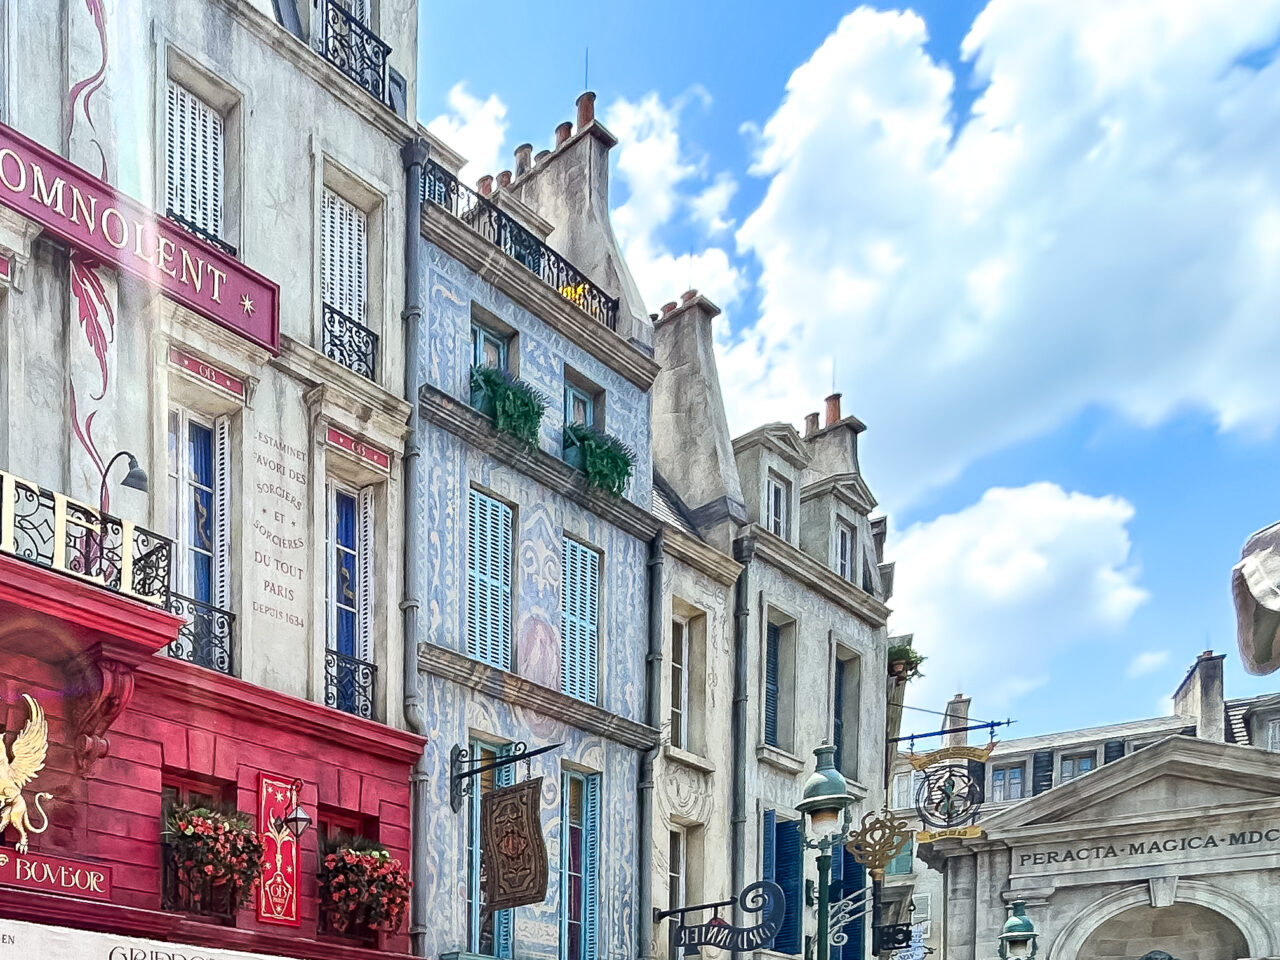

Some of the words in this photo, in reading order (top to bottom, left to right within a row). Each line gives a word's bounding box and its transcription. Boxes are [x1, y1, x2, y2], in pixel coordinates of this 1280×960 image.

[288, 469, 306, 486] DES
[256, 482, 302, 511] SORCIERS
[274, 511, 285, 524] ET
[254, 551, 271, 567] DU
[274, 558, 304, 580] TOUT
[263, 579, 294, 601] PARIS
[252, 601, 283, 620] DEPUIS
[285, 613, 304, 628] 1634
[1, 934, 15, 945] EN
